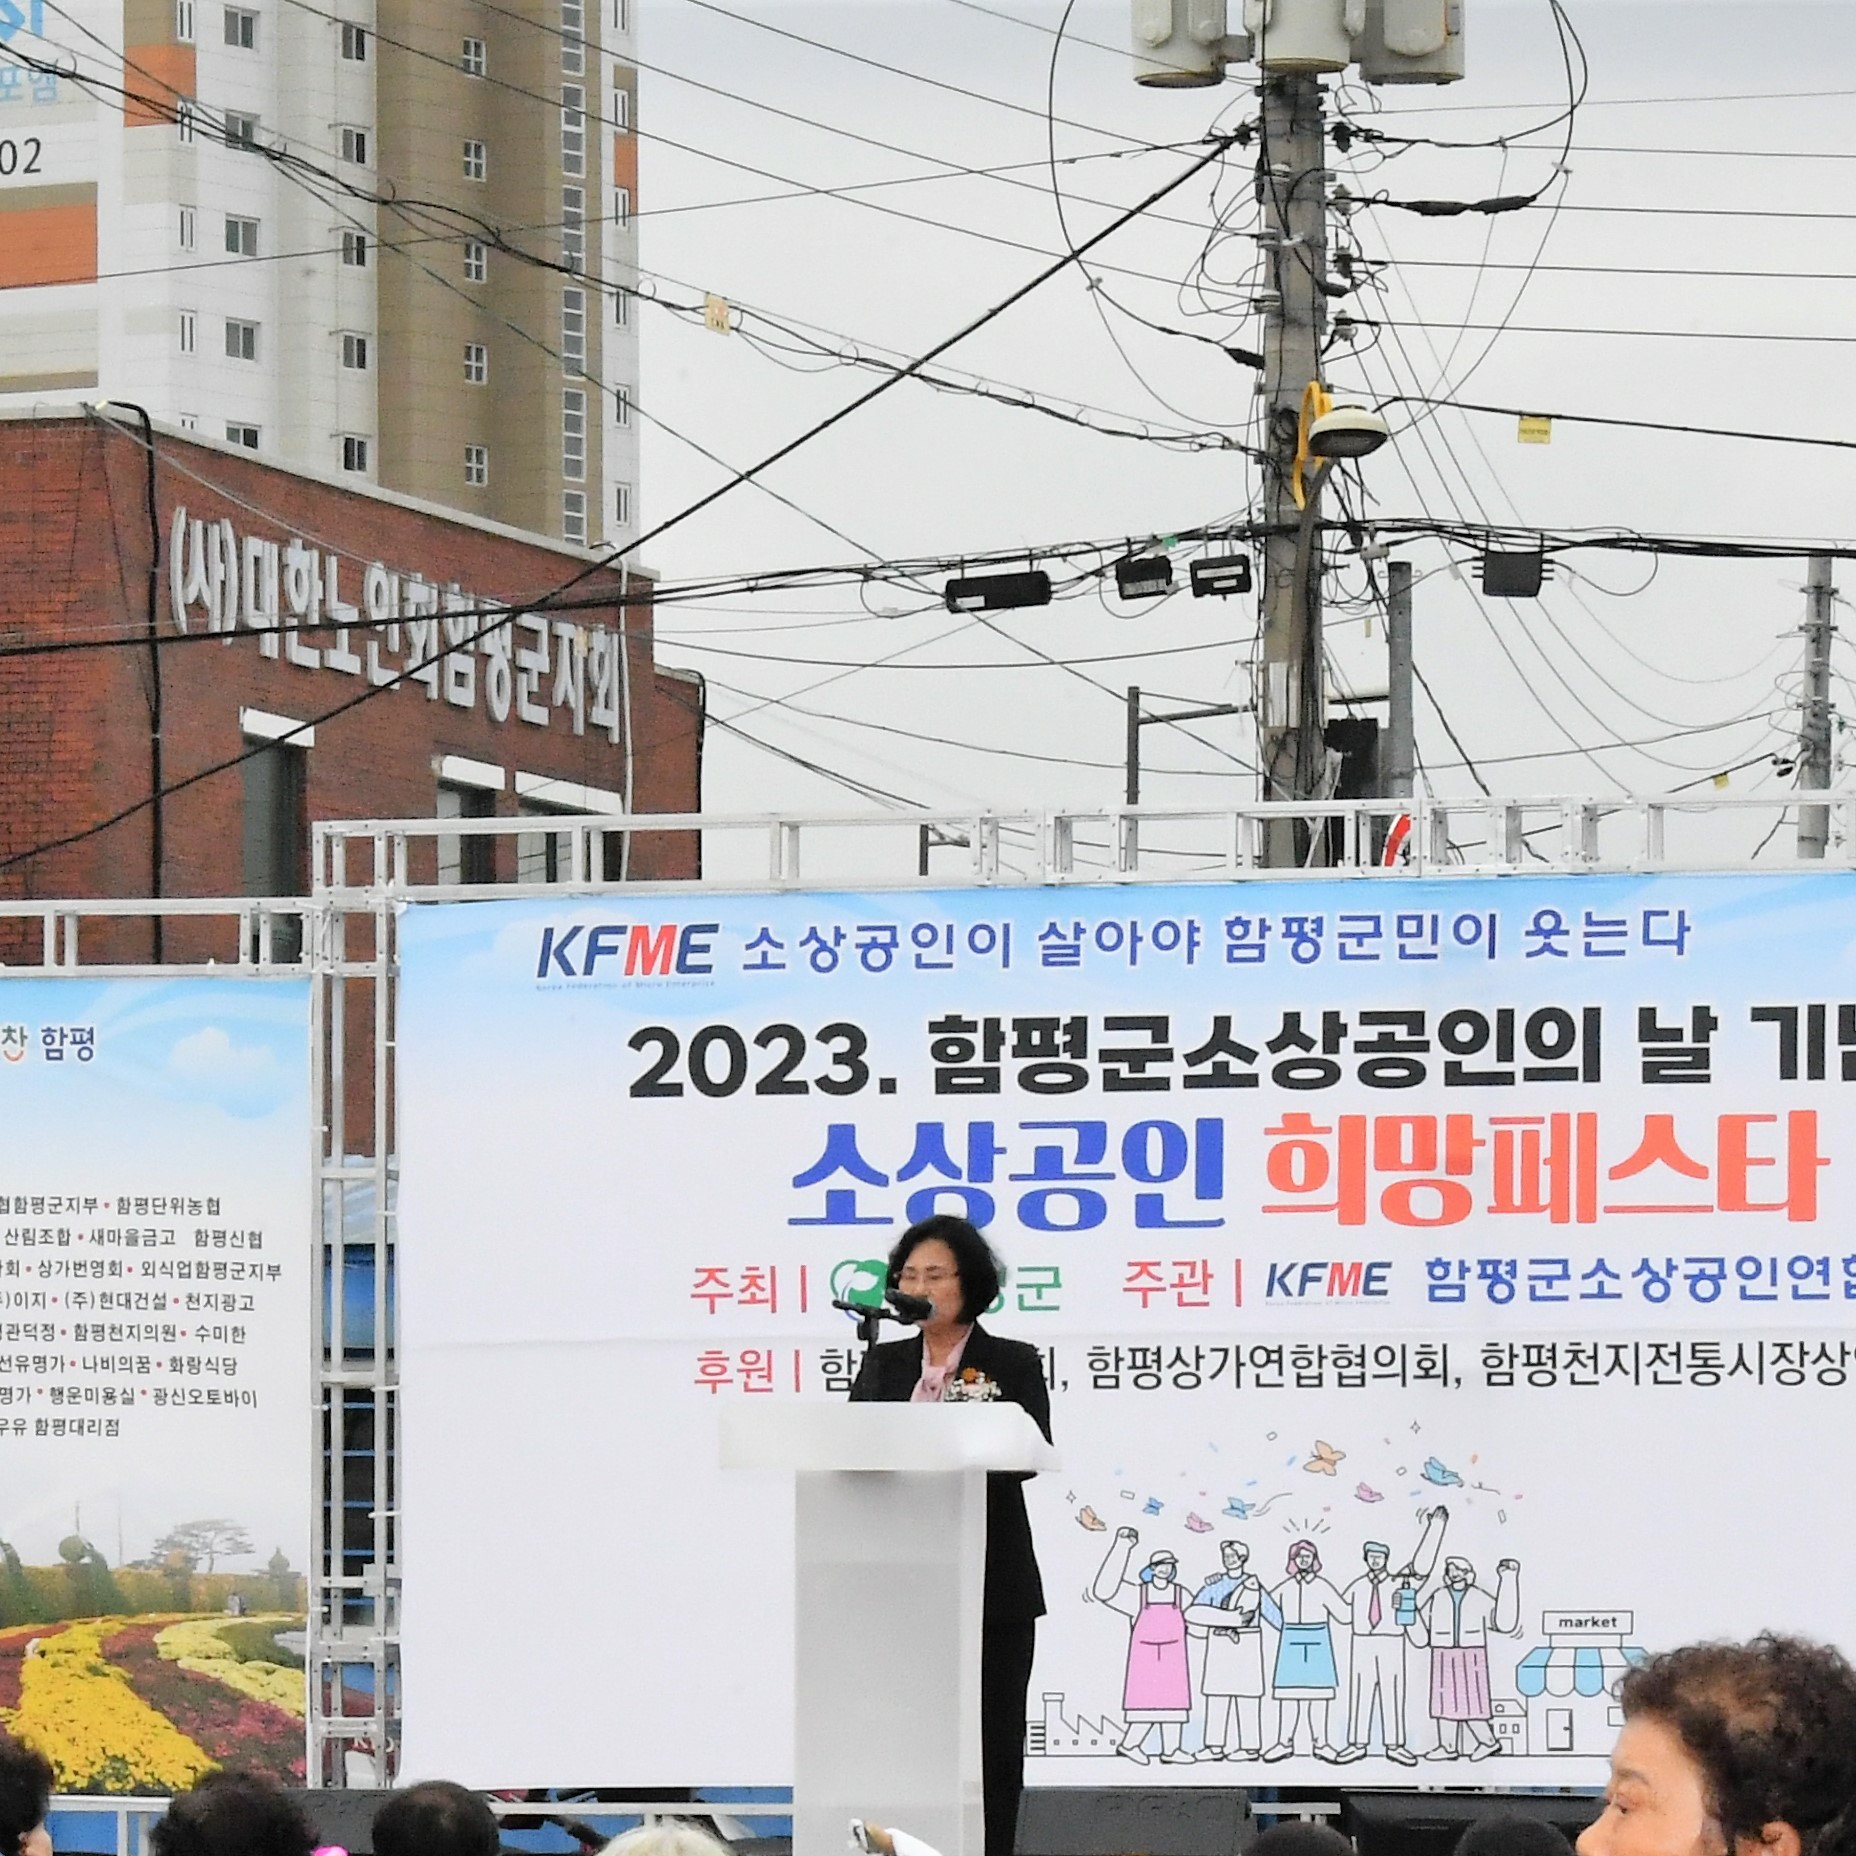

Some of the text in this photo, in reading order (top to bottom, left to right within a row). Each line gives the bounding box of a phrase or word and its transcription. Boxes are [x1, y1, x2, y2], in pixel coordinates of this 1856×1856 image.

[536, 923, 720, 978] KFME
[743, 907, 1693, 974] 소상공인이 살아야 함평군민이 웃는다
[41, 1025, 96, 1064] 함평
[627, 1021, 898, 1098] 2023.
[928, 1006, 1601, 1096] 함평군소상공인의
[1639, 1004, 1719, 1084] 날
[787, 1109, 1831, 1233] 소상공인 희망페스타
[117, 1196, 221, 1217] 함평단위농협
[4, 1228, 71, 1247] 산림조합
[89, 1228, 177, 1247] 새마을금고
[194, 1229, 263, 1250] 함평신협
[38, 1259, 123, 1278] 상가번영회
[141, 1260, 282, 1282] 외식업함평군지부
[690, 1264, 778, 1314] 주최
[1122, 1259, 1215, 1310] 주관
[1265, 1261, 1393, 1298] KFME
[694, 1347, 774, 1394] 후원
[1086, 1341, 1464, 1391] 함평상가연합협의회,
[35, 1418, 120, 1437] 함평대리점
[1559, 1616, 1618, 1628] market
